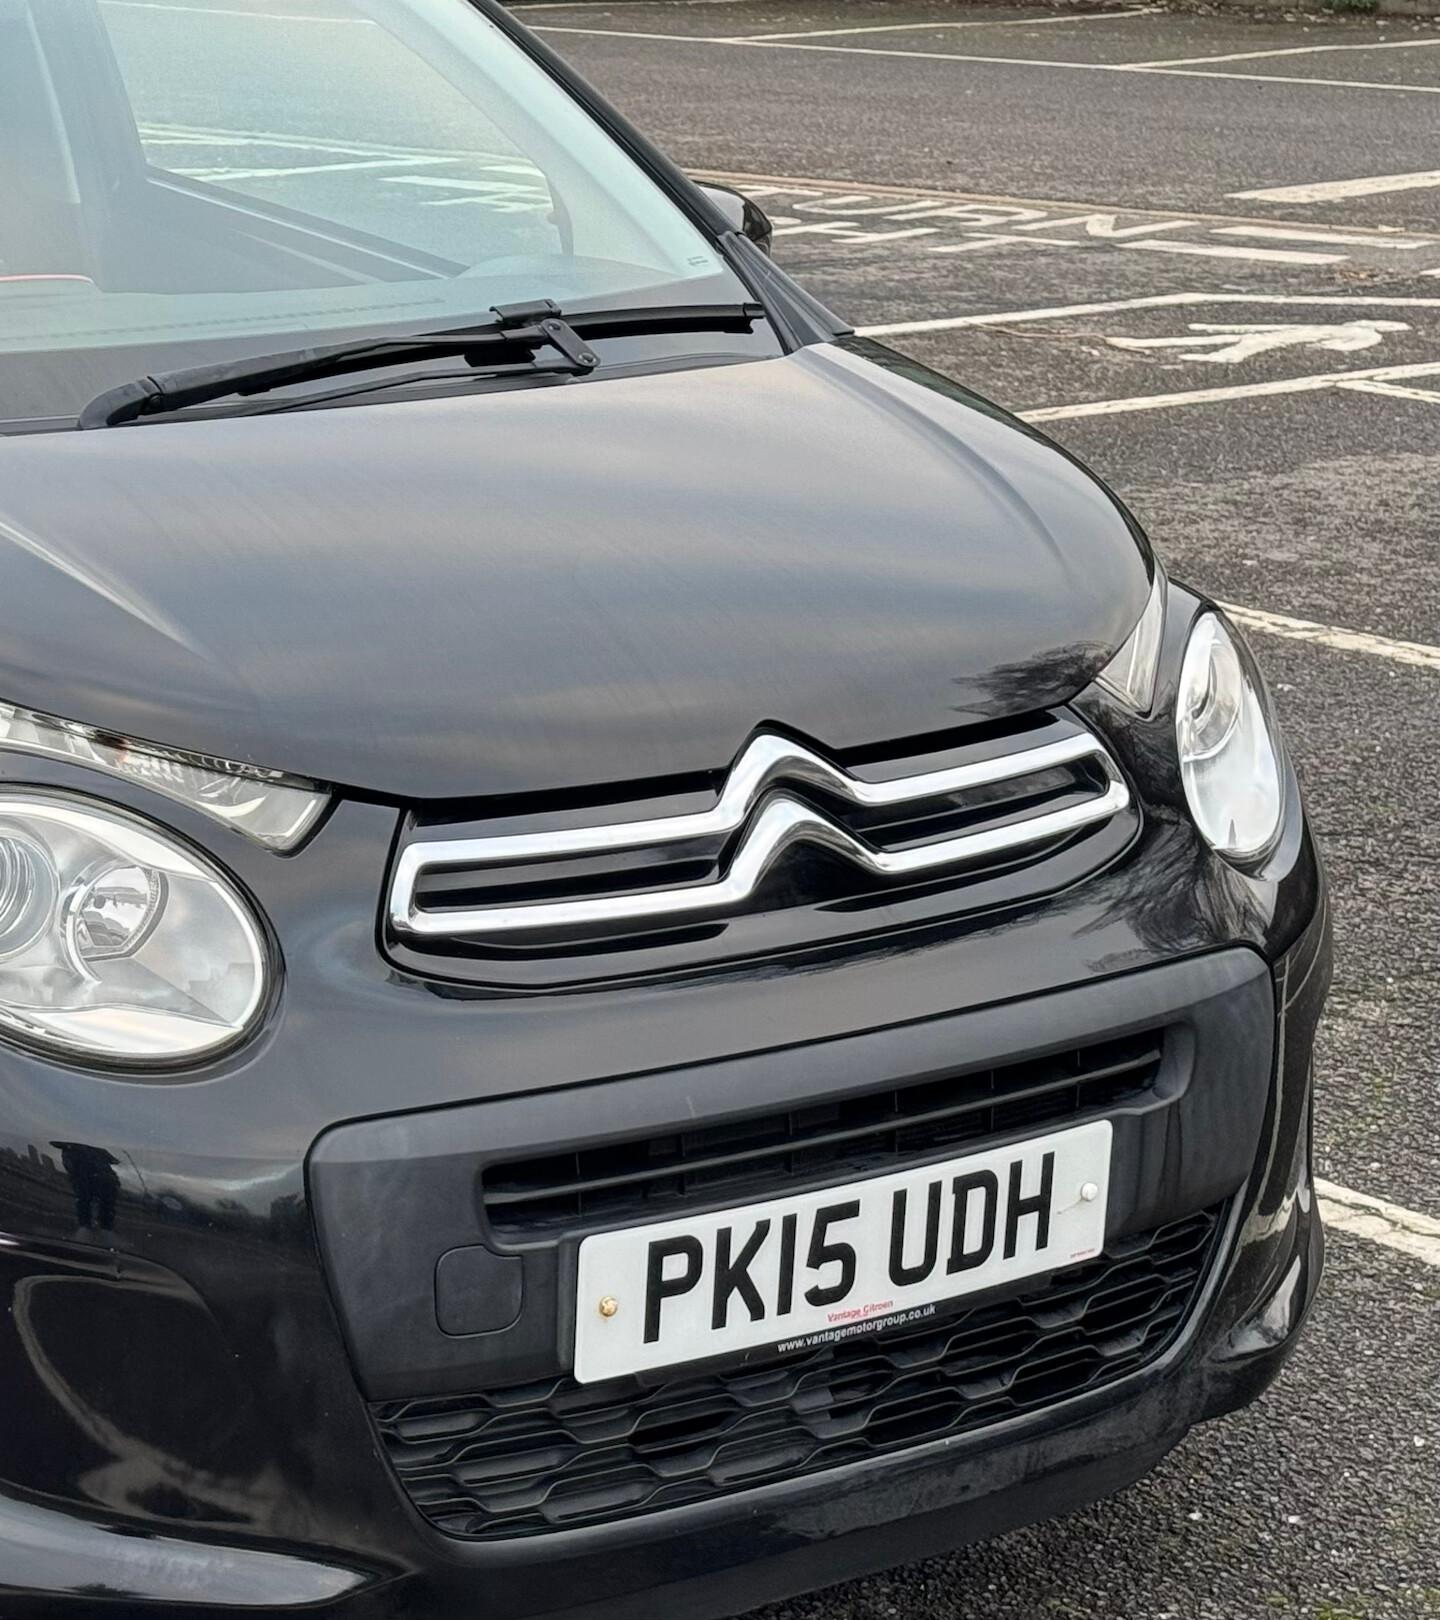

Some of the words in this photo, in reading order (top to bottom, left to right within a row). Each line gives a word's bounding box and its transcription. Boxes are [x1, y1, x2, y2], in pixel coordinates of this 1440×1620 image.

[643, 1199, 860, 1344] PK15
[888, 1151, 1055, 1287] UDH
[777, 1304, 936, 1352] www.vantagemotorgroup.co.uk
[827, 1308, 862, 1322] Vantage
